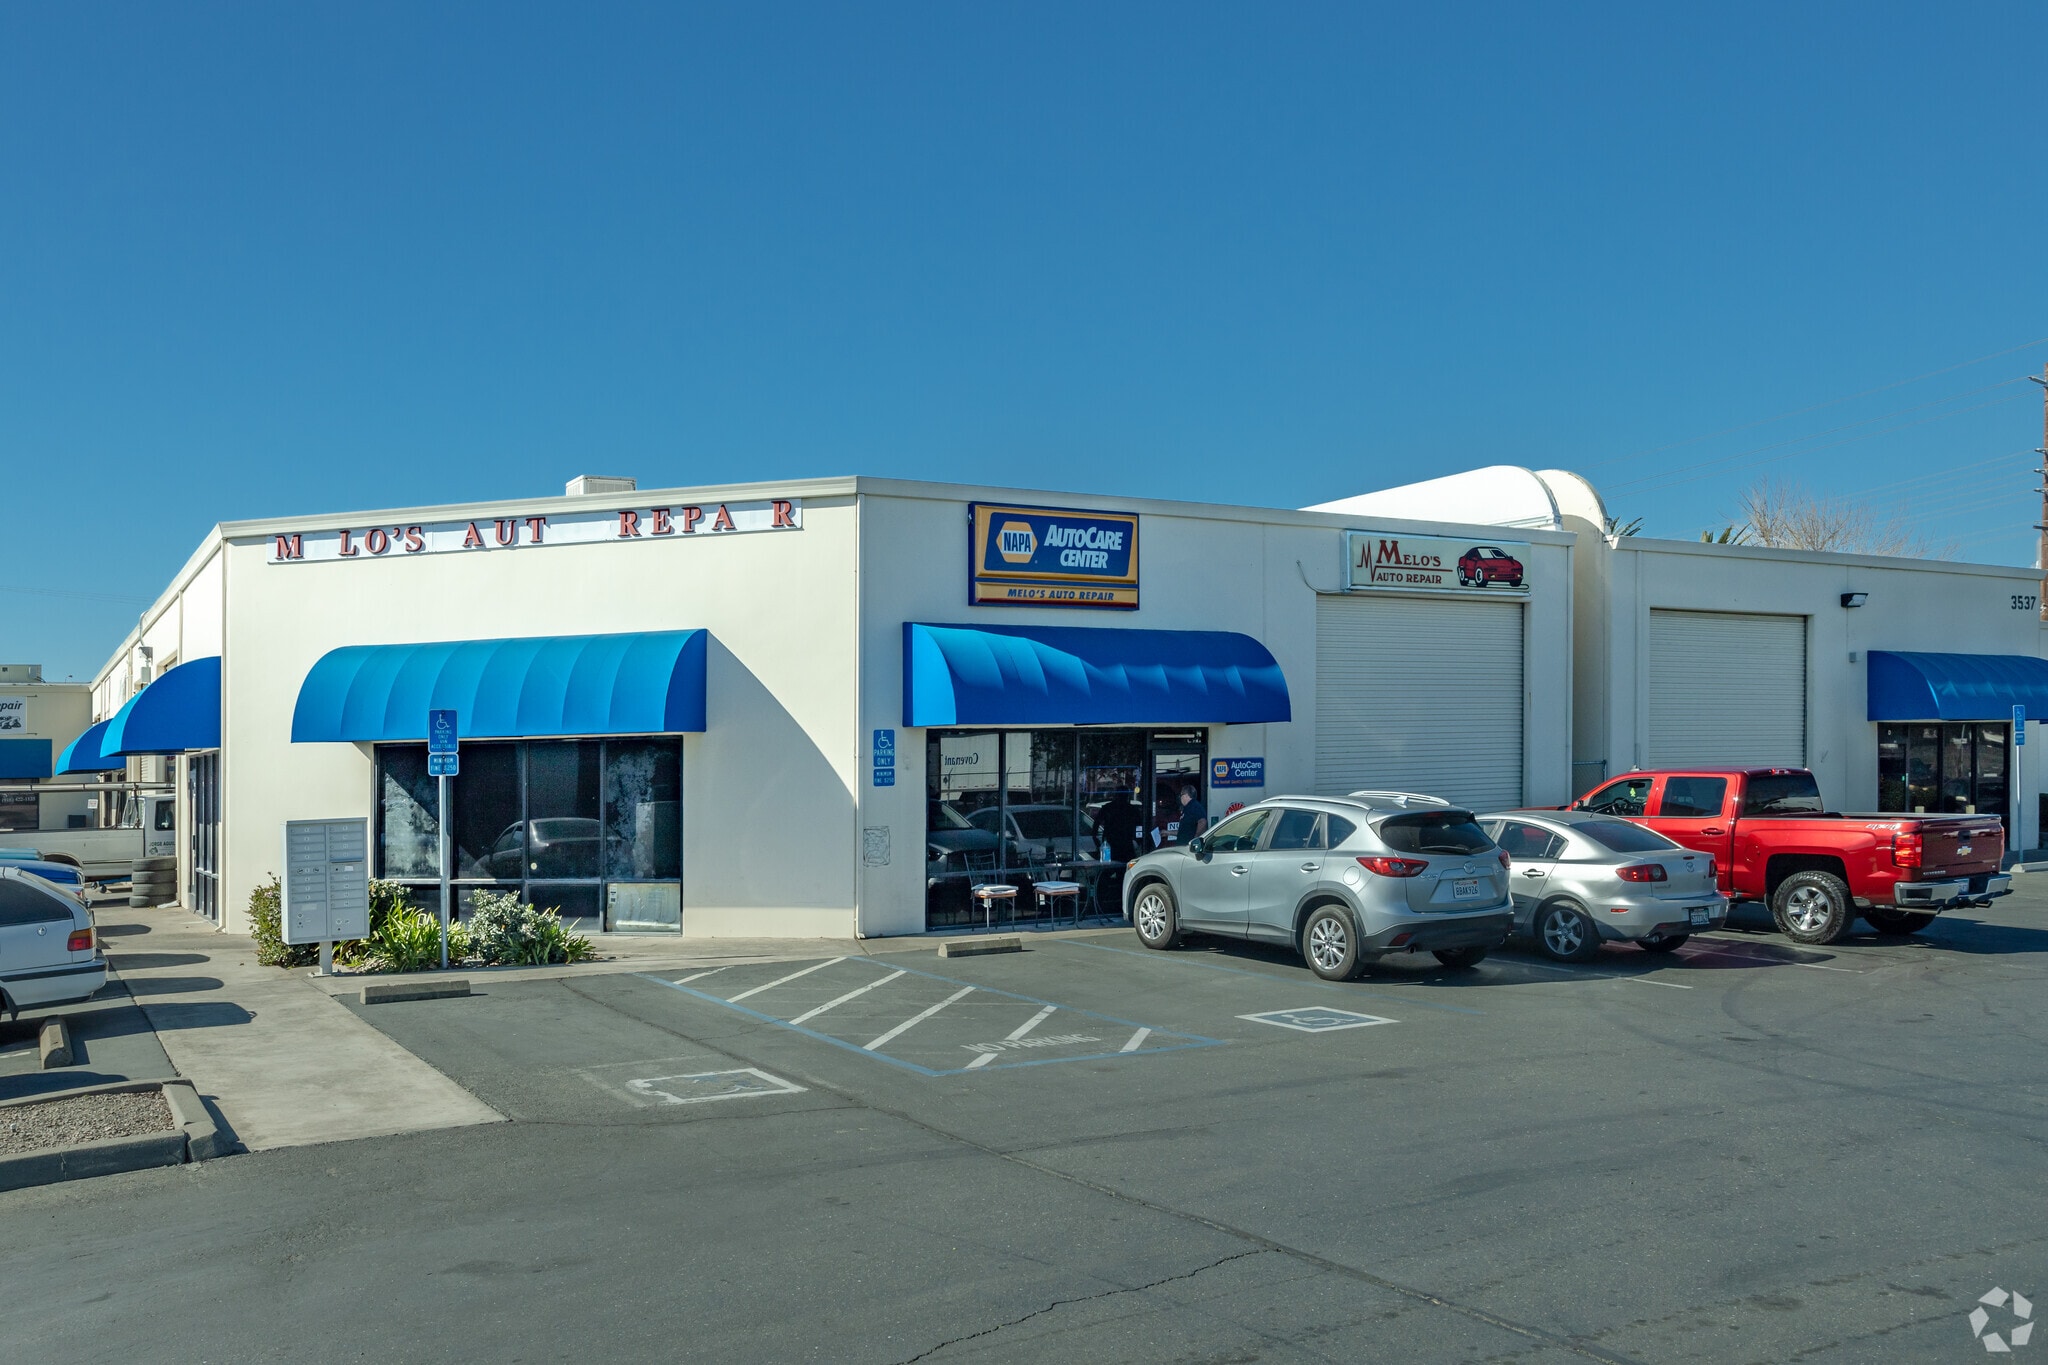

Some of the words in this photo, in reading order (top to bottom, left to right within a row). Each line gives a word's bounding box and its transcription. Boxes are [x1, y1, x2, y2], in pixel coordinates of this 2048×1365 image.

[1003, 531, 1032, 553] NAPA
[1060, 549, 1109, 569] CENTER
[1376, 539, 1442, 567] MELO'S
[1376, 572, 1404, 582] AUTO
[1406, 573, 1442, 584] REPAIR
[1007, 588, 1046, 599] MELO'S
[1049, 590, 1078, 600] AUTO
[1079, 591, 1115, 601] REPAIR
[2010, 595, 2037, 610] 3537
[0, 700, 23, 712] pair
[874, 748, 895, 757] PARKING
[877, 757, 891, 765] ONLY
[1231, 761, 1262, 769] AutoCare
[1234, 769, 1258, 777] Center
[960, 1042, 1007, 1054] NO
[999, 1033, 1102, 1049] PARKING
